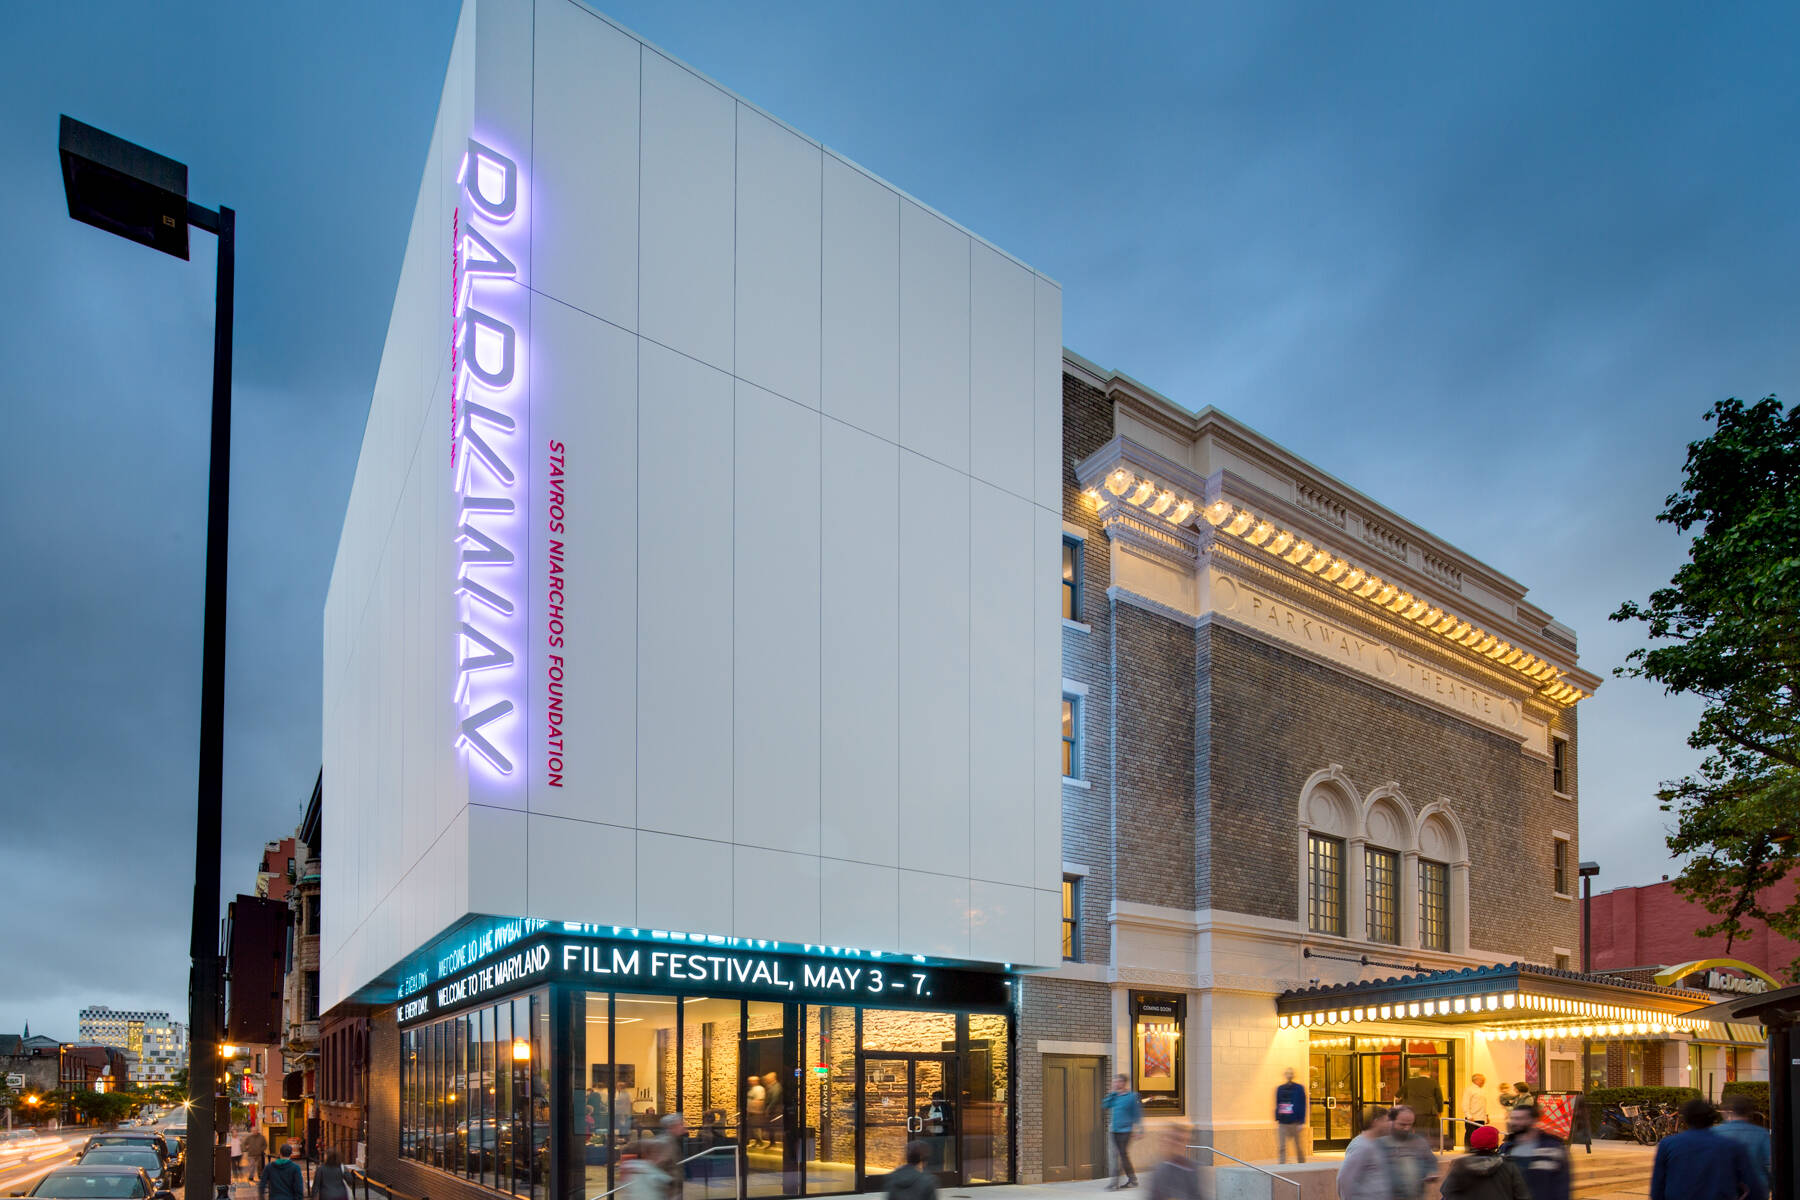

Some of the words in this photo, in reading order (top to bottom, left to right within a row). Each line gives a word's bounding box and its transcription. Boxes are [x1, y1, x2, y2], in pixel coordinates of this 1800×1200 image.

[459, 137, 518, 776] PARKWAY
[548, 439, 565, 534] STAVROS
[548, 539, 565, 649] NIARCHOS
[1253, 597, 1366, 661] PARKWAY
[1407, 664, 1491, 714] THEATRE
[547, 653, 564, 788] FOUNDATION
[438, 978, 468, 1007] WELCOME
[467, 973, 478, 996] TO
[478, 966, 494, 992] THE
[494, 944, 550, 986] MARYLAND
[563, 944, 639, 975] FILM
[651, 950, 794, 991] FESTIVAL,
[804, 964, 861, 990] MAY
[867, 970, 883, 993] 3
[912, 974, 932, 996] 7.
[1142, 1004, 1160, 1013] COMING
[1709, 970, 1768, 994] McDonald's
